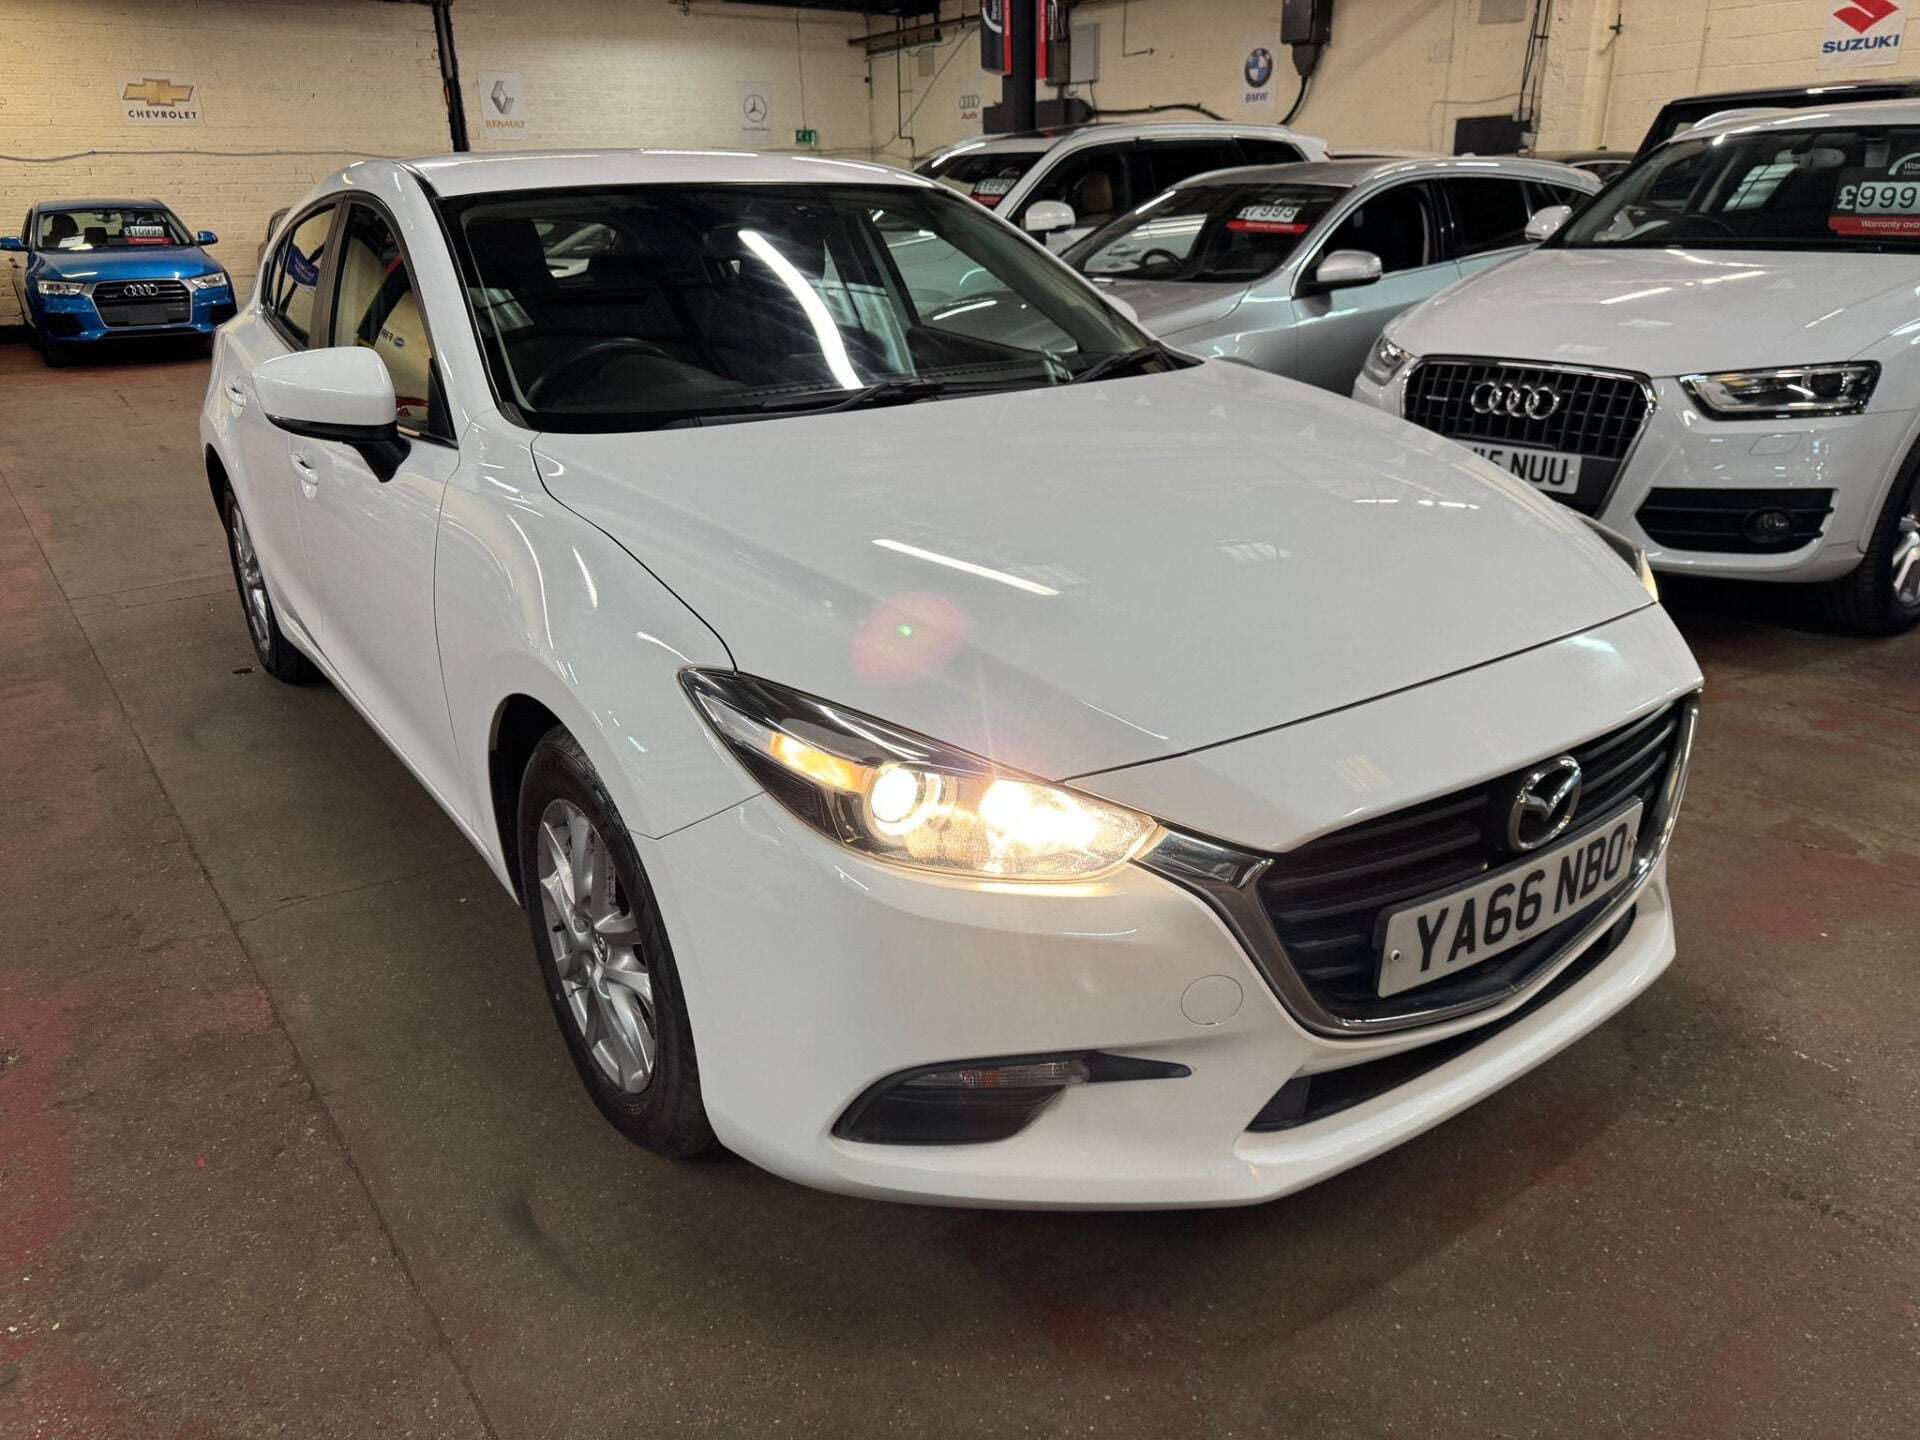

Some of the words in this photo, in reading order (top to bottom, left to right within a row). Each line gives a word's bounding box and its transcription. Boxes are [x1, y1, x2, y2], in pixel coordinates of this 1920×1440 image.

[1822, 34, 1899, 53] SUZUKI
[1245, 92, 1269, 103] BMW
[128, 110, 197, 119] CHEVROLET
[485, 119, 525, 129] RENAULT
[1861, 220, 1901, 230] Warranty
[1510, 452, 1569, 486] NUU
[1416, 868, 1546, 973] YA66
[1553, 822, 1628, 914] NBO
